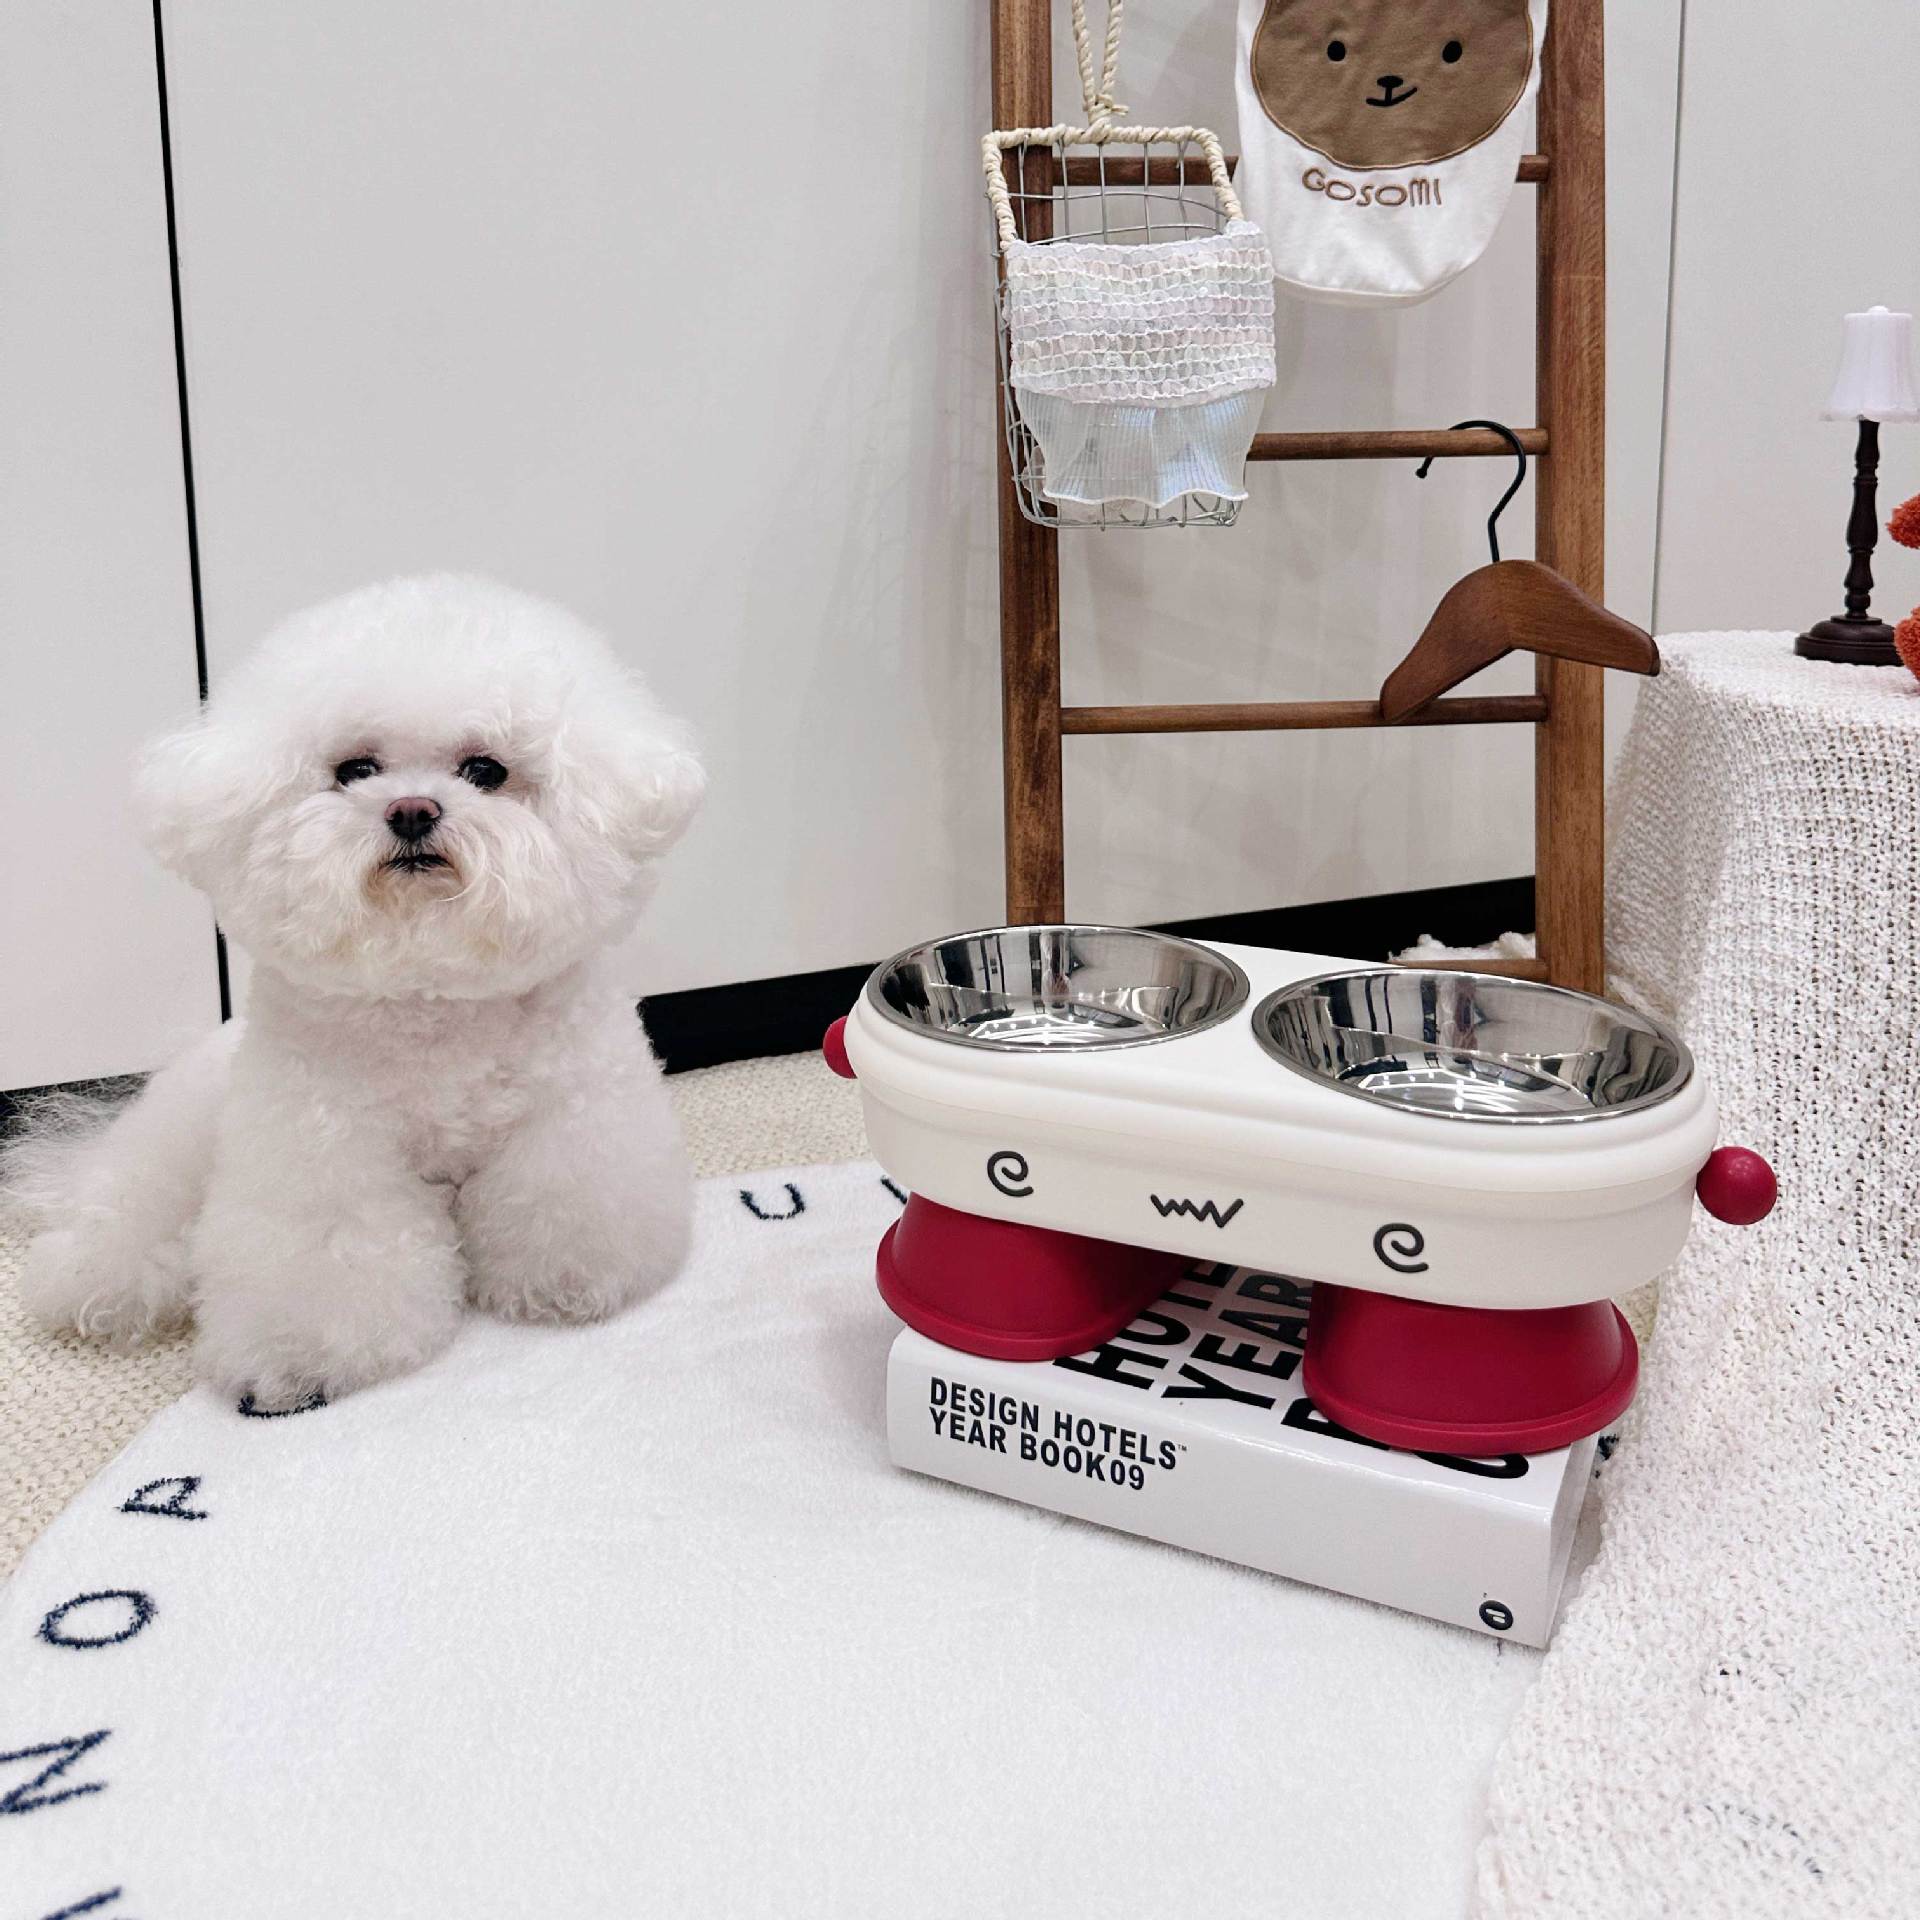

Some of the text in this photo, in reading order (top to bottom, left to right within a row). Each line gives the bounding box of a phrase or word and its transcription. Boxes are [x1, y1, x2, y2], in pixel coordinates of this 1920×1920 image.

[1302, 167, 1442, 208] GOSOMI
[930, 1376, 1039, 1433] DESIGN
[928, 1406, 1007, 1454] YEAR
